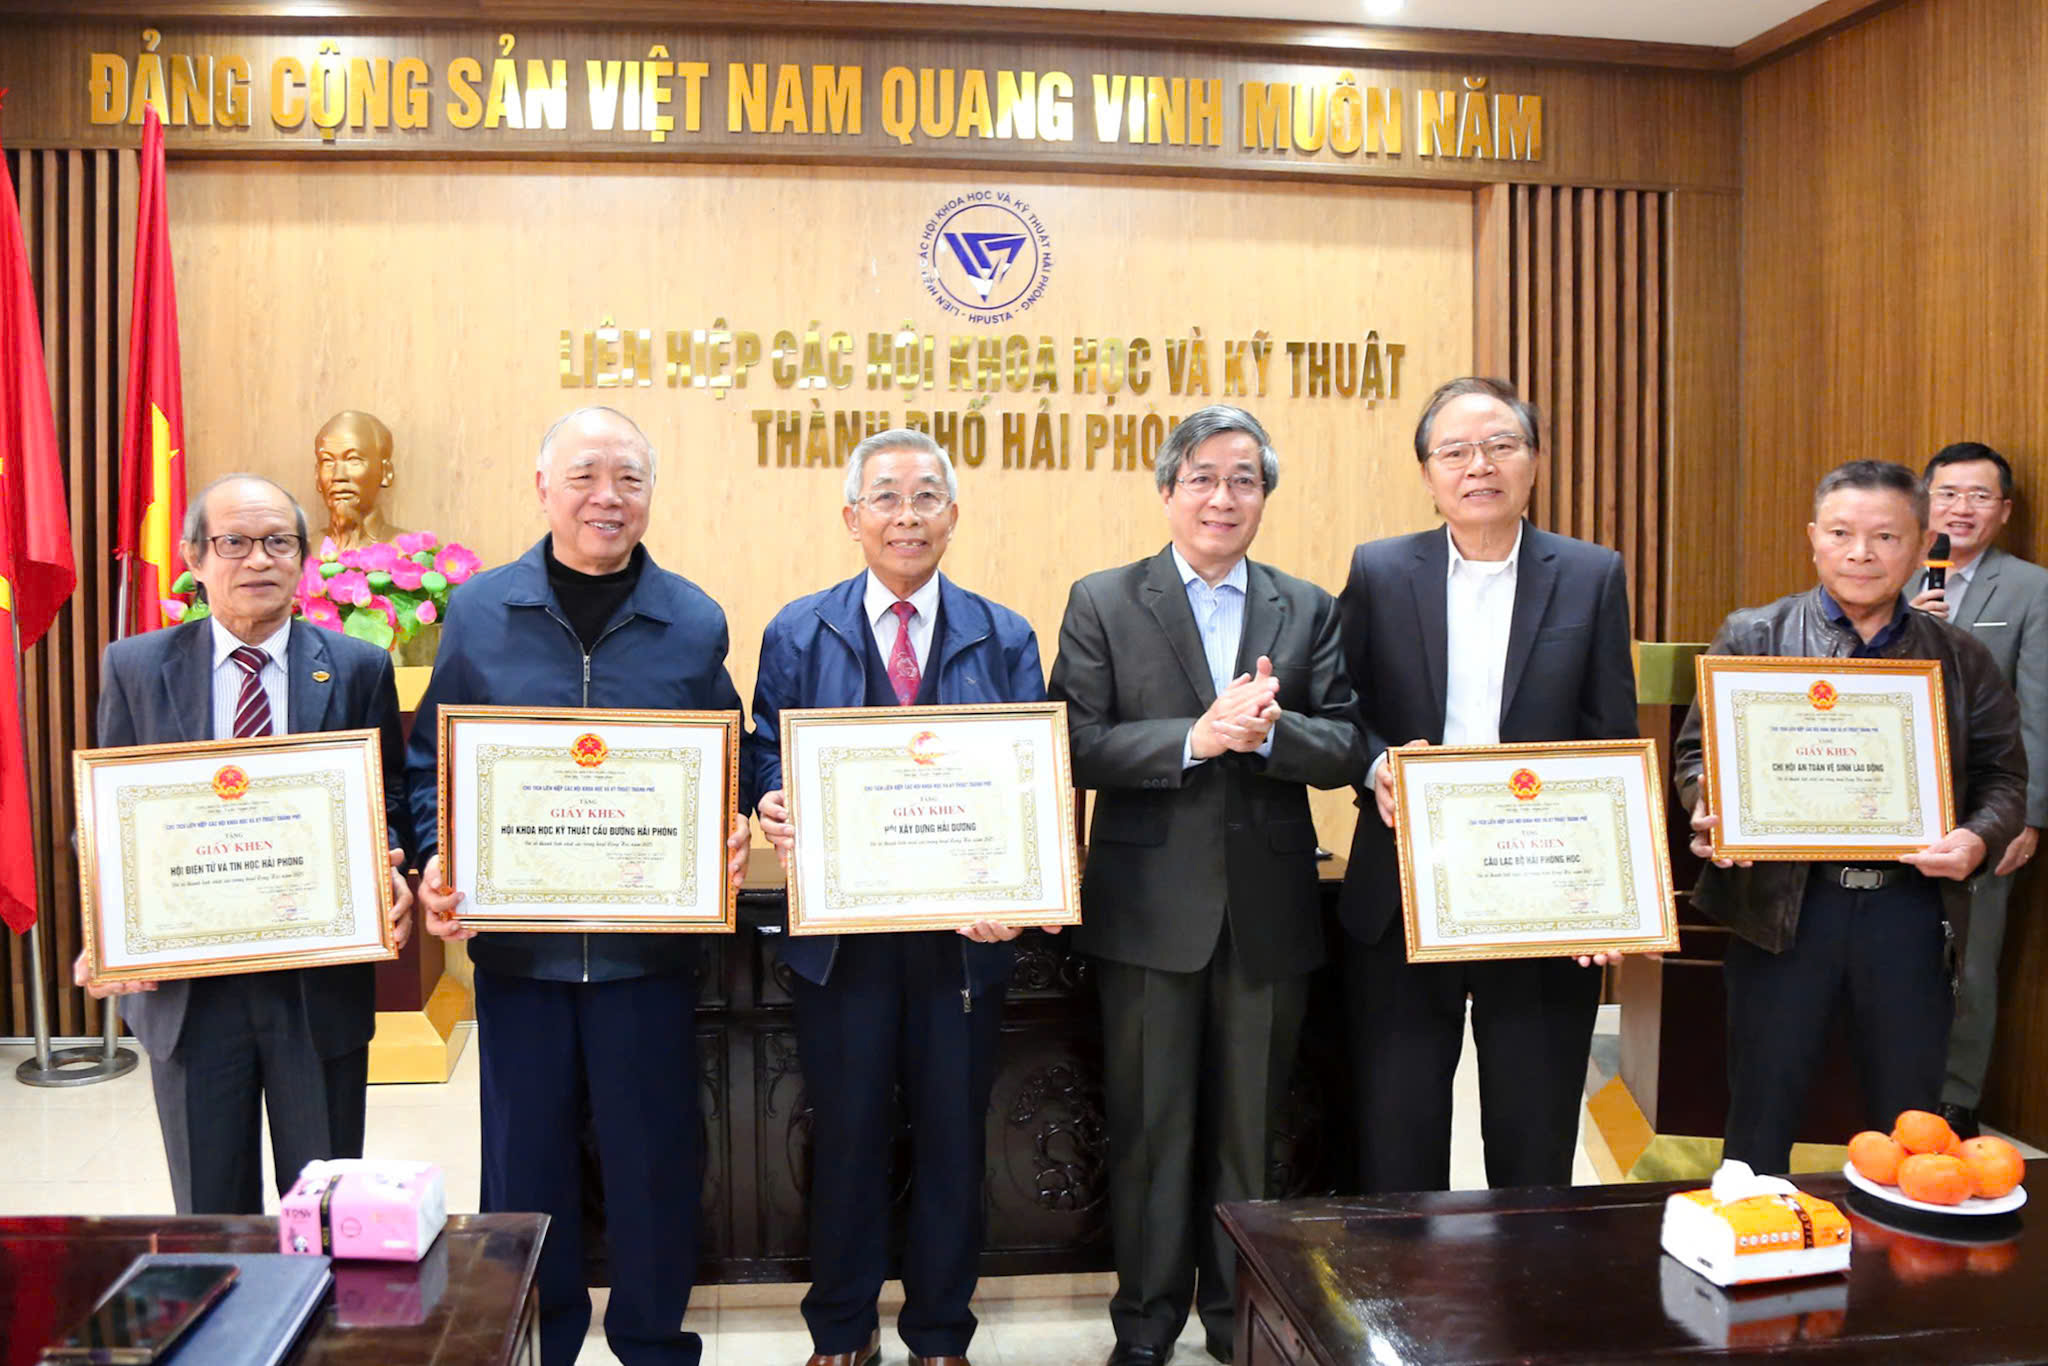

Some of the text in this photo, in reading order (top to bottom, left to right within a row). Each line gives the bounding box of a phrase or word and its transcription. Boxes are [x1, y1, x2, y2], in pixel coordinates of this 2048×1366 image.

[89, 28, 1543, 161] ĐẢNG CỘNG SẢN VIỆT NAM QUANG VINH MUÔN NĂM
[935, 196, 965, 220] KHOA
[996, 191, 1012, 203] VÀ
[967, 311, 1014, 325] HPUSTA
[559, 315, 1406, 410] LIÊN HIỆP CÁC HỘI KHOA HỌC VÀ KỸ THUẬT
[1001, 396, 1069, 471] HẢI
[587, 809, 626, 819] KHEN
[501, 824, 514, 836] HỘI
[516, 826, 536, 835] KHOA
[538, 826, 553, 837] HỌC
[234, 841, 274, 854] KHEN
[229, 861, 242, 871] TIN
